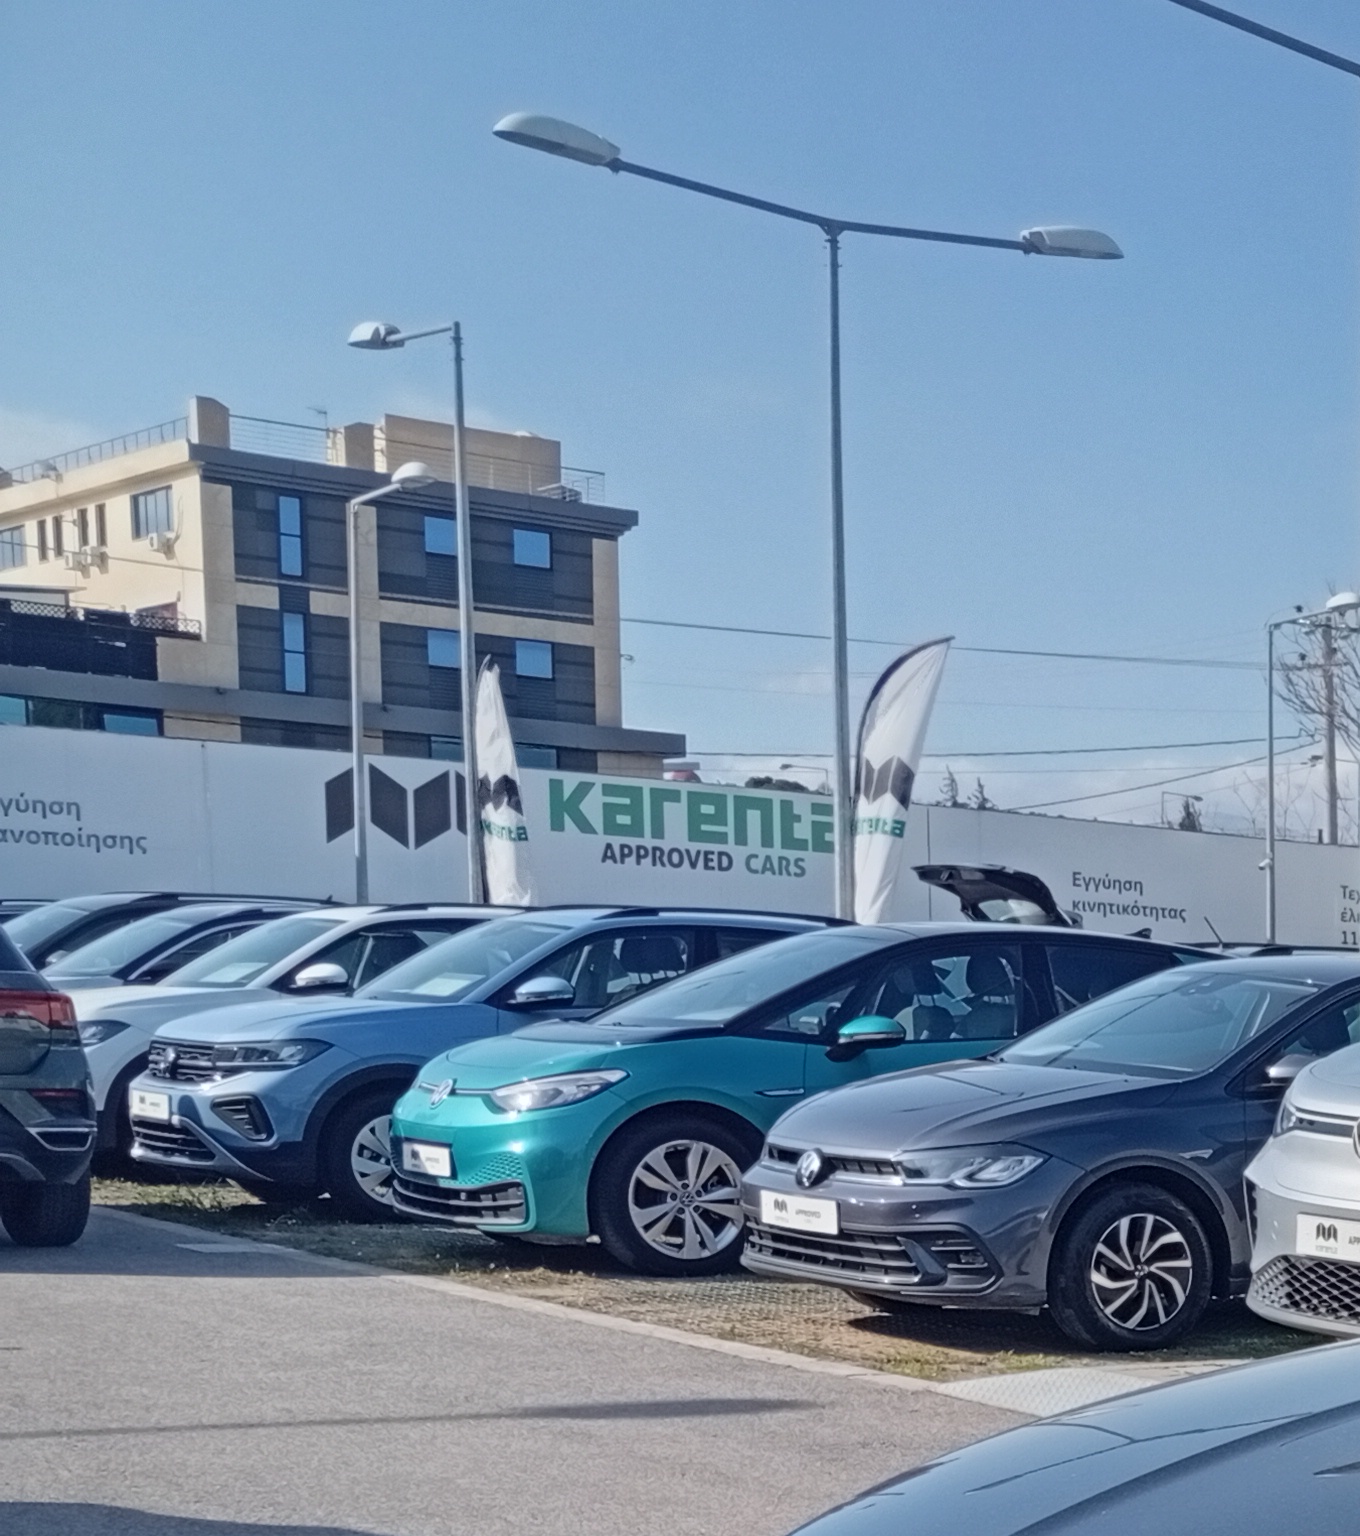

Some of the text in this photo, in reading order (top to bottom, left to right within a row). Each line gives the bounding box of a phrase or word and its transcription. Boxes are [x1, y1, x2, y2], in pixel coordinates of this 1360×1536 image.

[601, 842, 807, 878] APPROVED CARS
[1072, 871, 1143, 896] Εγγύηση
[1072, 900, 1187, 923] κινητικότητας
